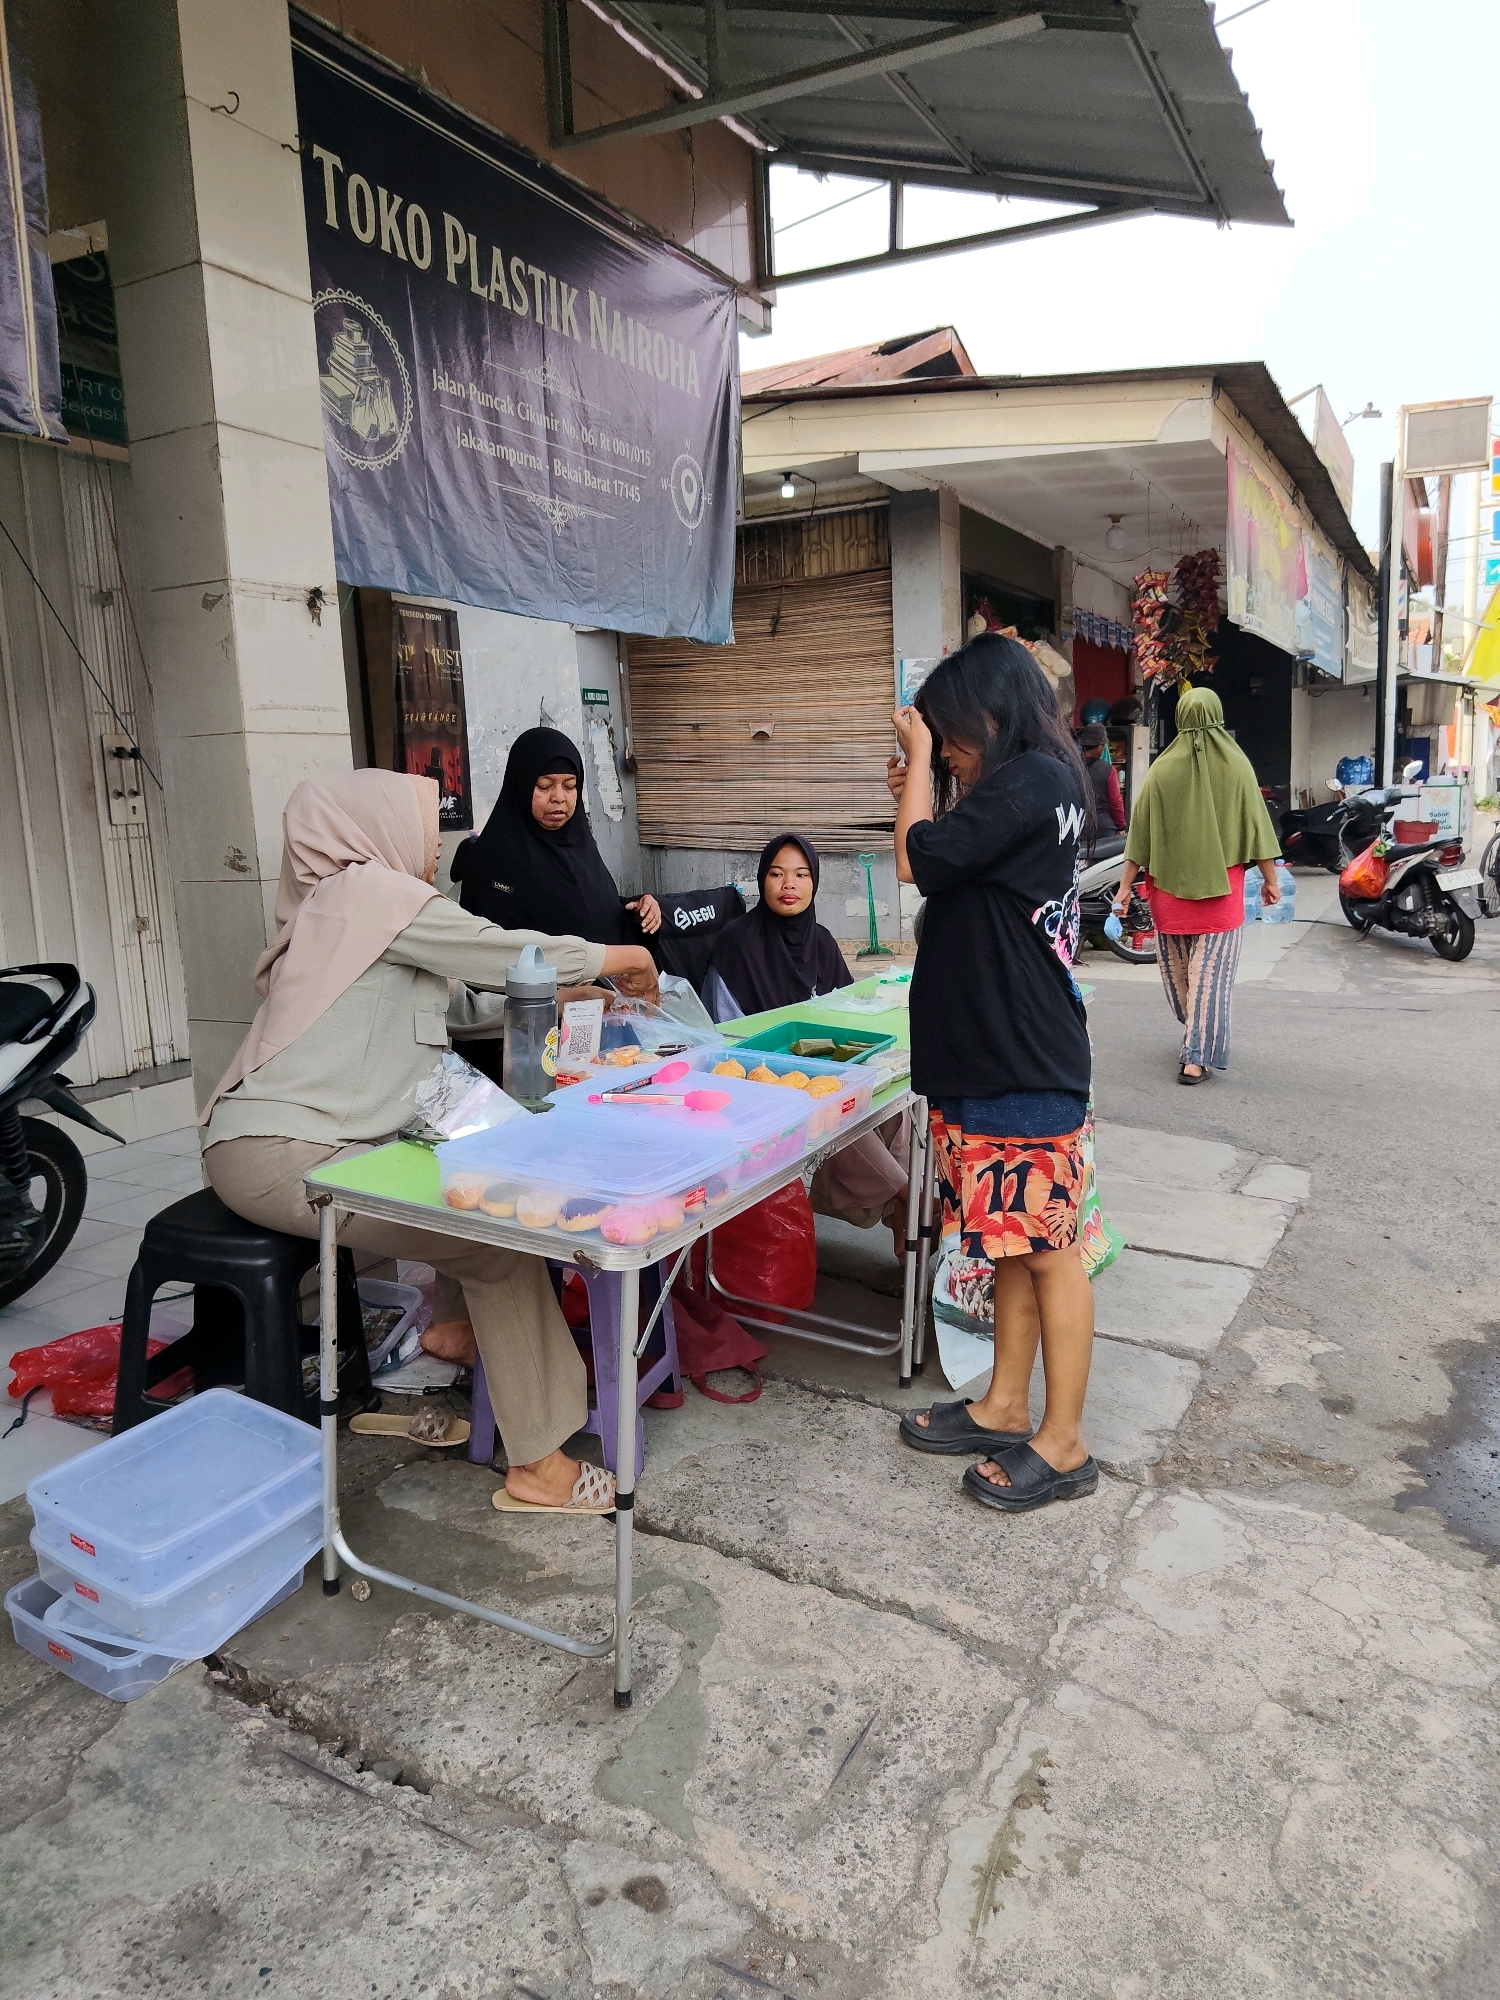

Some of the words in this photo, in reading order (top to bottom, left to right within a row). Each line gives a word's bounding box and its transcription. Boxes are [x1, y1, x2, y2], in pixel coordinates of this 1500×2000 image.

[312, 143, 432, 271] TOKO
[442, 211, 581, 344] PLASTIK
[588, 289, 701, 399] NAIROHA
[432, 368, 466, 399] Jalan
[469, 382, 515, 417] Puncak
[517, 401, 560, 432] Cikunir
[562, 417, 579, 441] No.
[581, 426, 597, 447] 06.
[600, 432, 611, 452] Rt
[613, 438, 651, 467] 001/015
[456, 426, 543, 472] Jakasampurna
[584, 469, 611, 494] Barat
[613, 479, 641, 503] 17145
[399, 609, 425, 620] TERSEDIA
[404, 711, 457, 723] FRAGRANCE
[689, 904, 716, 927] JEGU
